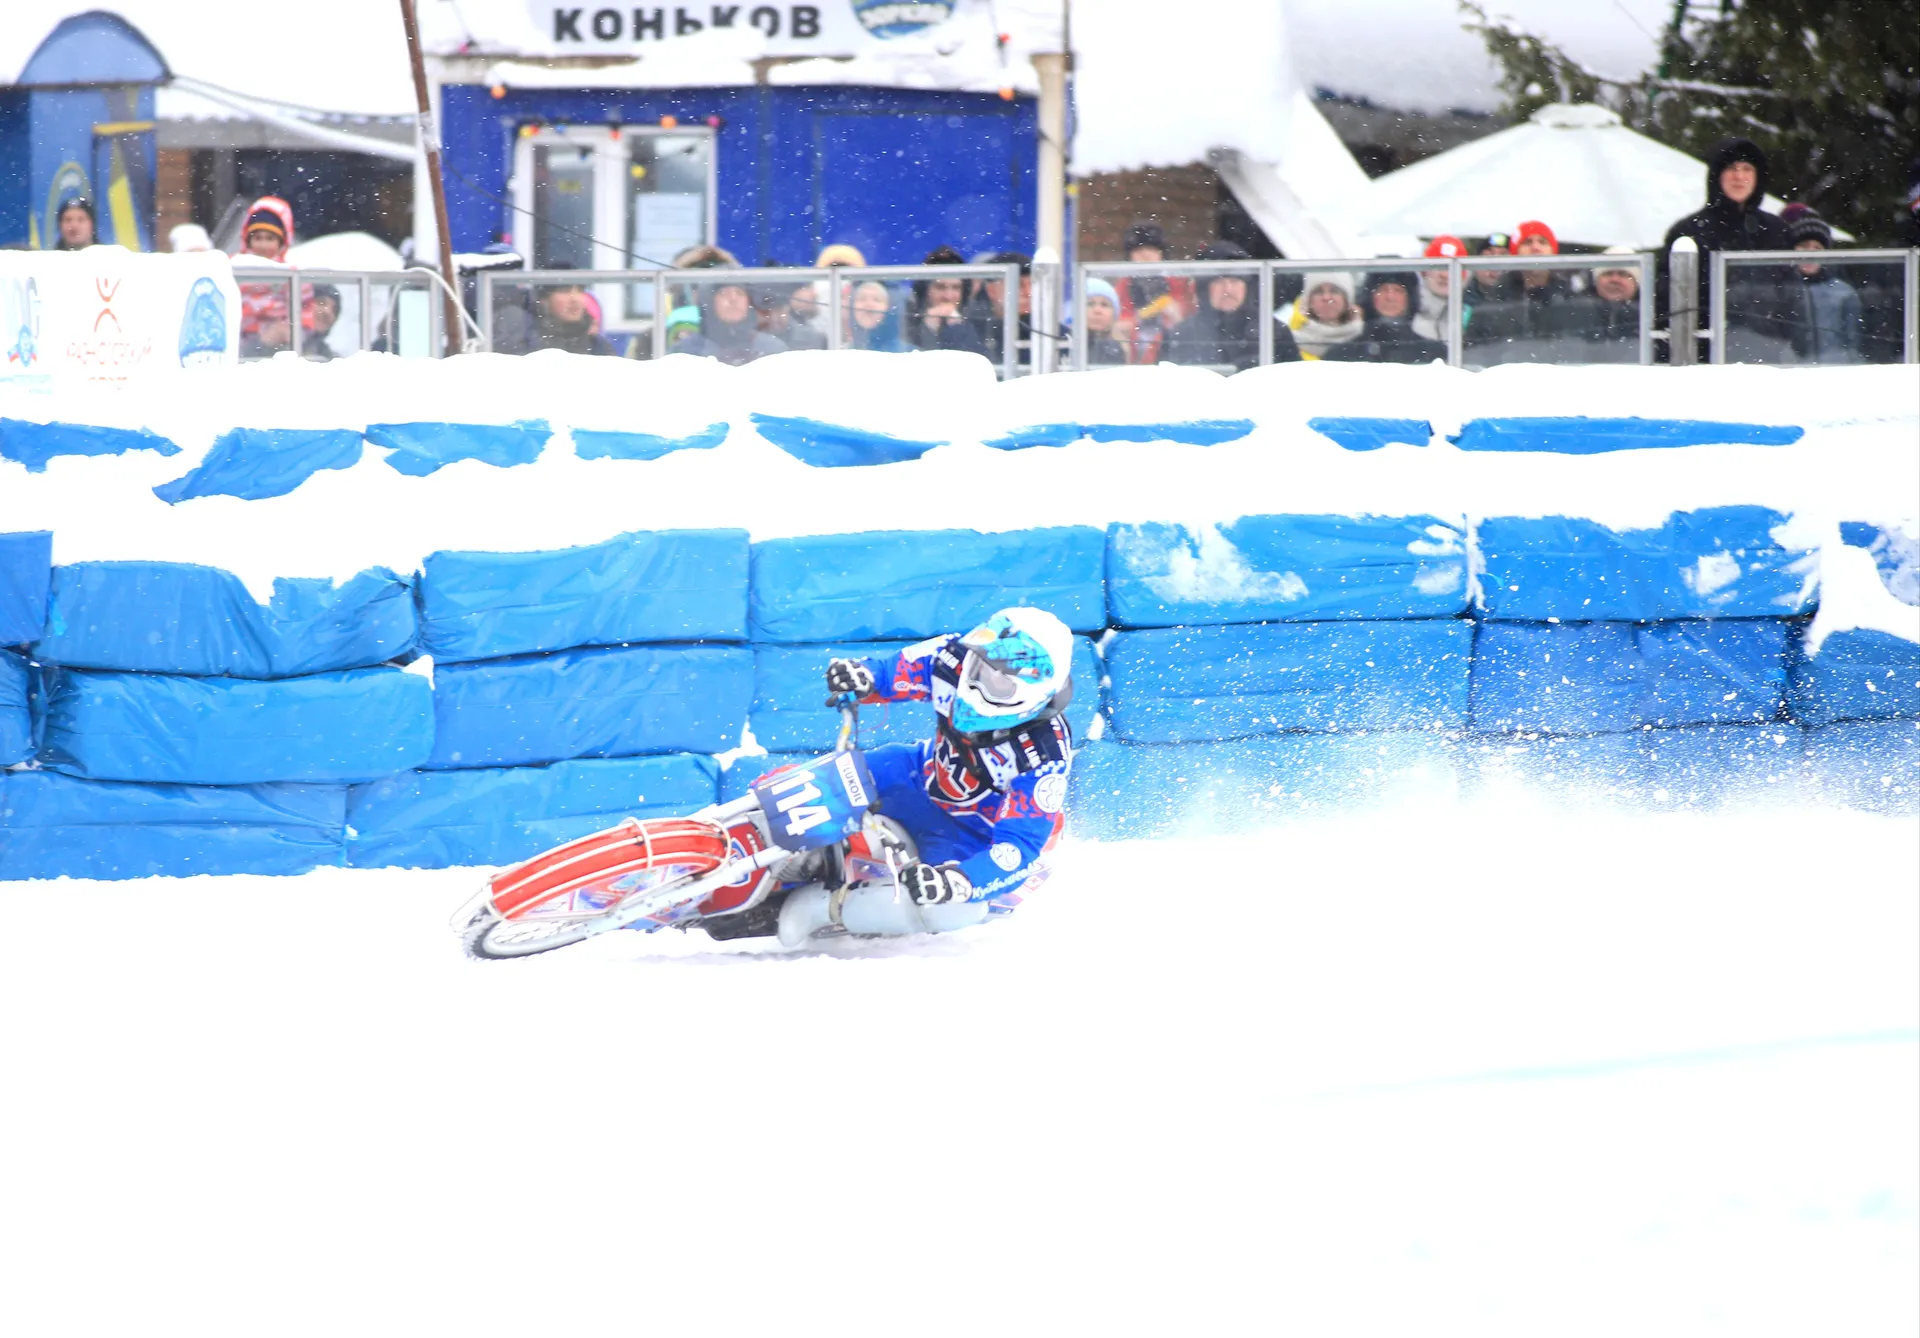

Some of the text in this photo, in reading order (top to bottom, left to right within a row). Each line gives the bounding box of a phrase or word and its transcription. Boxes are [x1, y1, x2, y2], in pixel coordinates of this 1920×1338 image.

[553, 6, 821, 43] КОНЬКОВ
[771, 769, 832, 836] 114
[842, 764, 863, 803] LUKOIL
